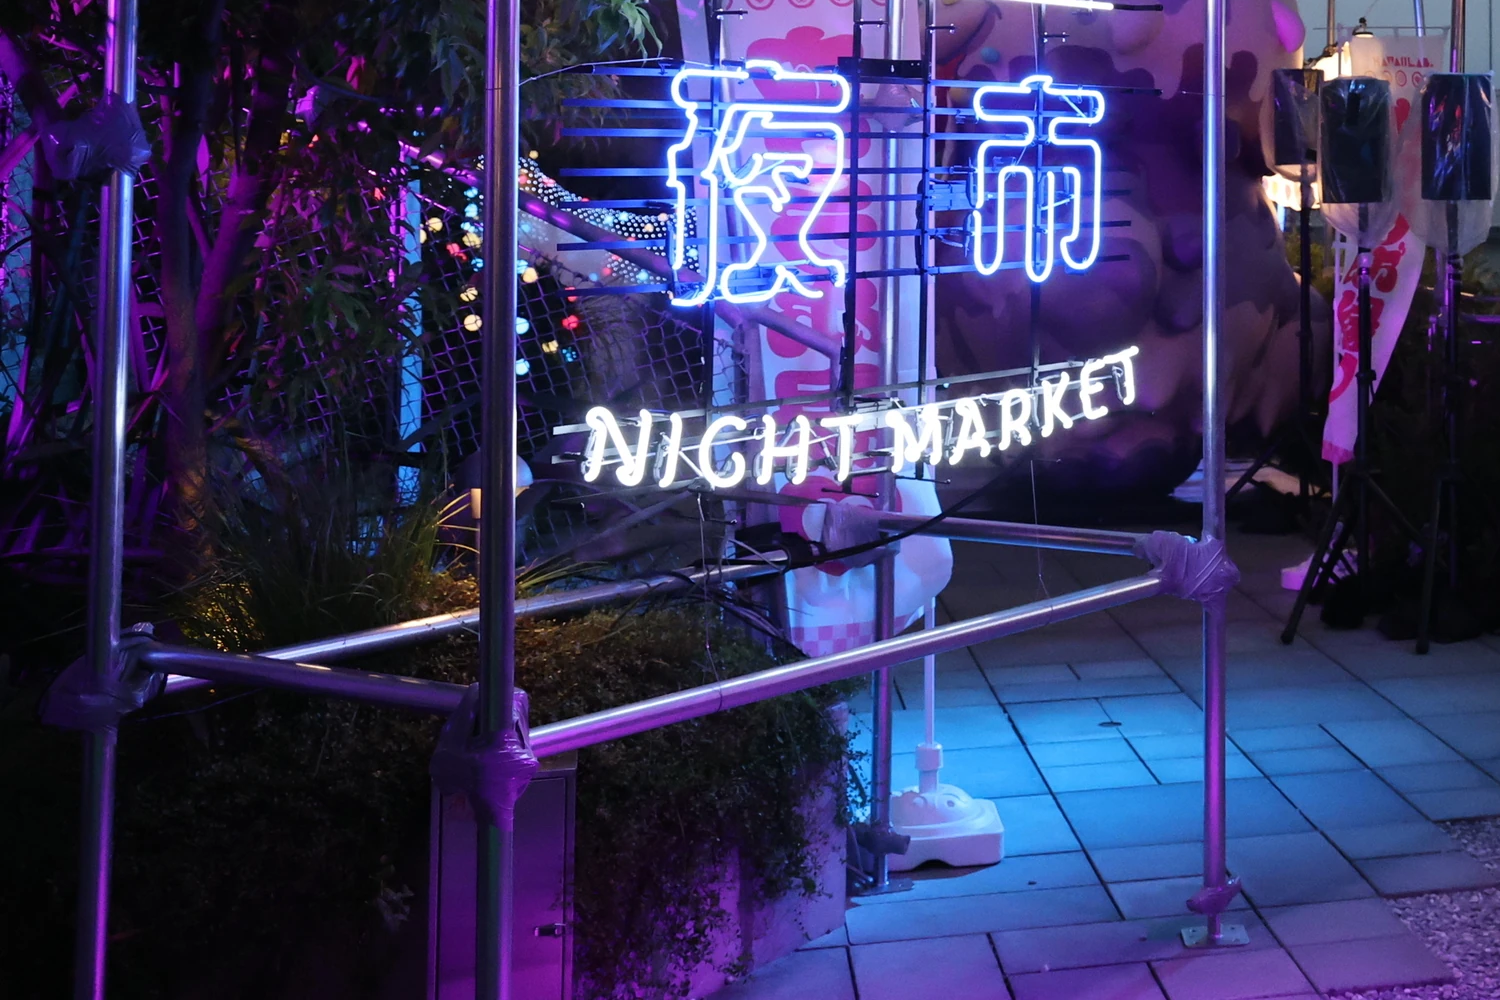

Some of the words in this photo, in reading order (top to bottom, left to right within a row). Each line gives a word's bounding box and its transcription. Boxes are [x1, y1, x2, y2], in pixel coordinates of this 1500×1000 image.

[667, 60, 1106, 307] 夜市
[585, 405, 863, 488] NIGHT
[886, 345, 1140, 474] MARKET
